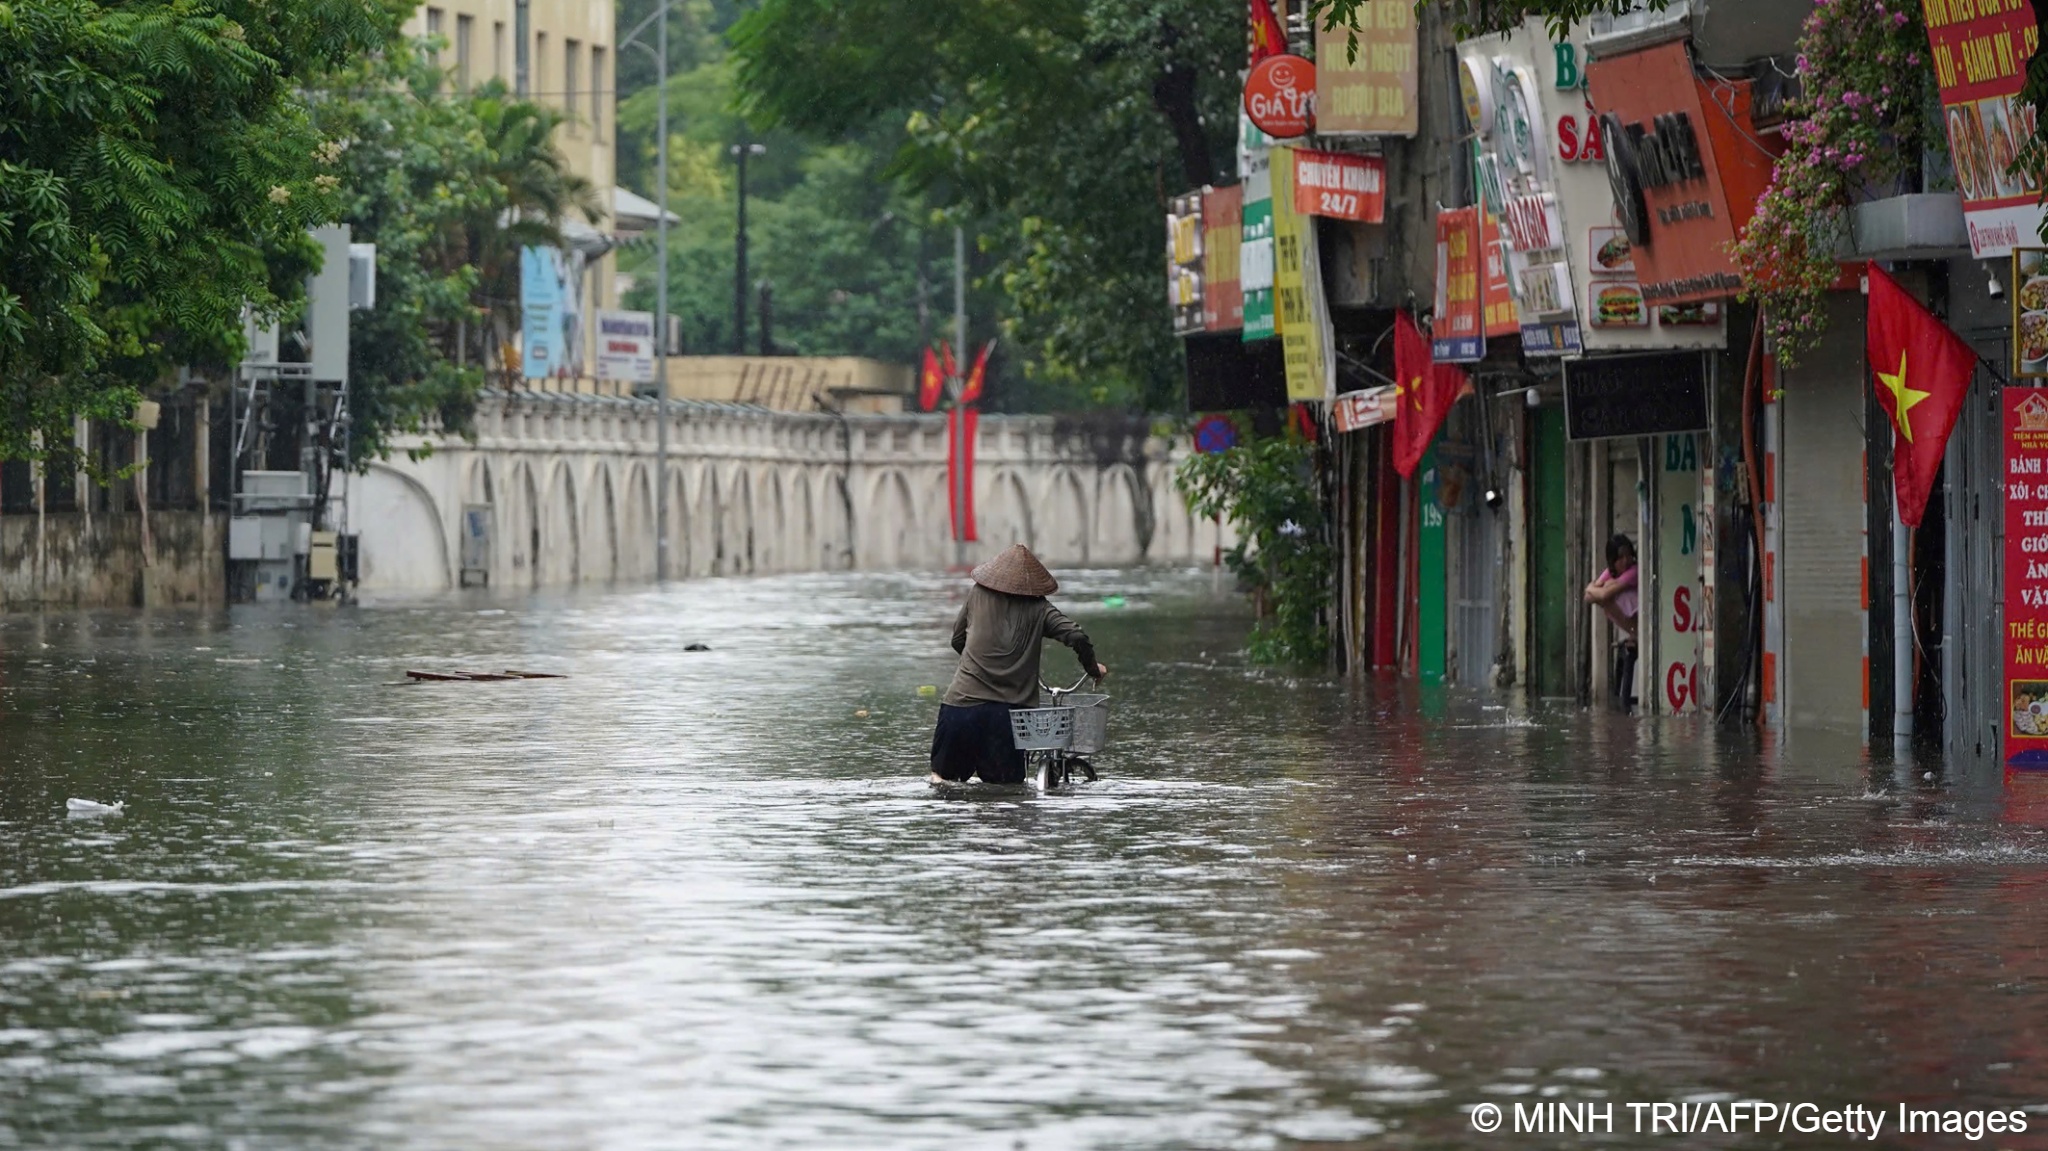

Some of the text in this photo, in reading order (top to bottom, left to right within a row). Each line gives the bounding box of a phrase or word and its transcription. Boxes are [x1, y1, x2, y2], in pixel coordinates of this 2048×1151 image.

[1933, 36, 1957, 88] XÔI
[1961, 30, 1997, 84] BÁNH
[1378, 87, 1405, 118] BIA
[1321, 192, 1357, 214] 24/7
[2010, 454, 2041, 474] BÁNH
[2009, 480, 2029, 500] XÔI
[2009, 618, 2034, 639] THẾ
[2015, 644, 2033, 664] ĂN
